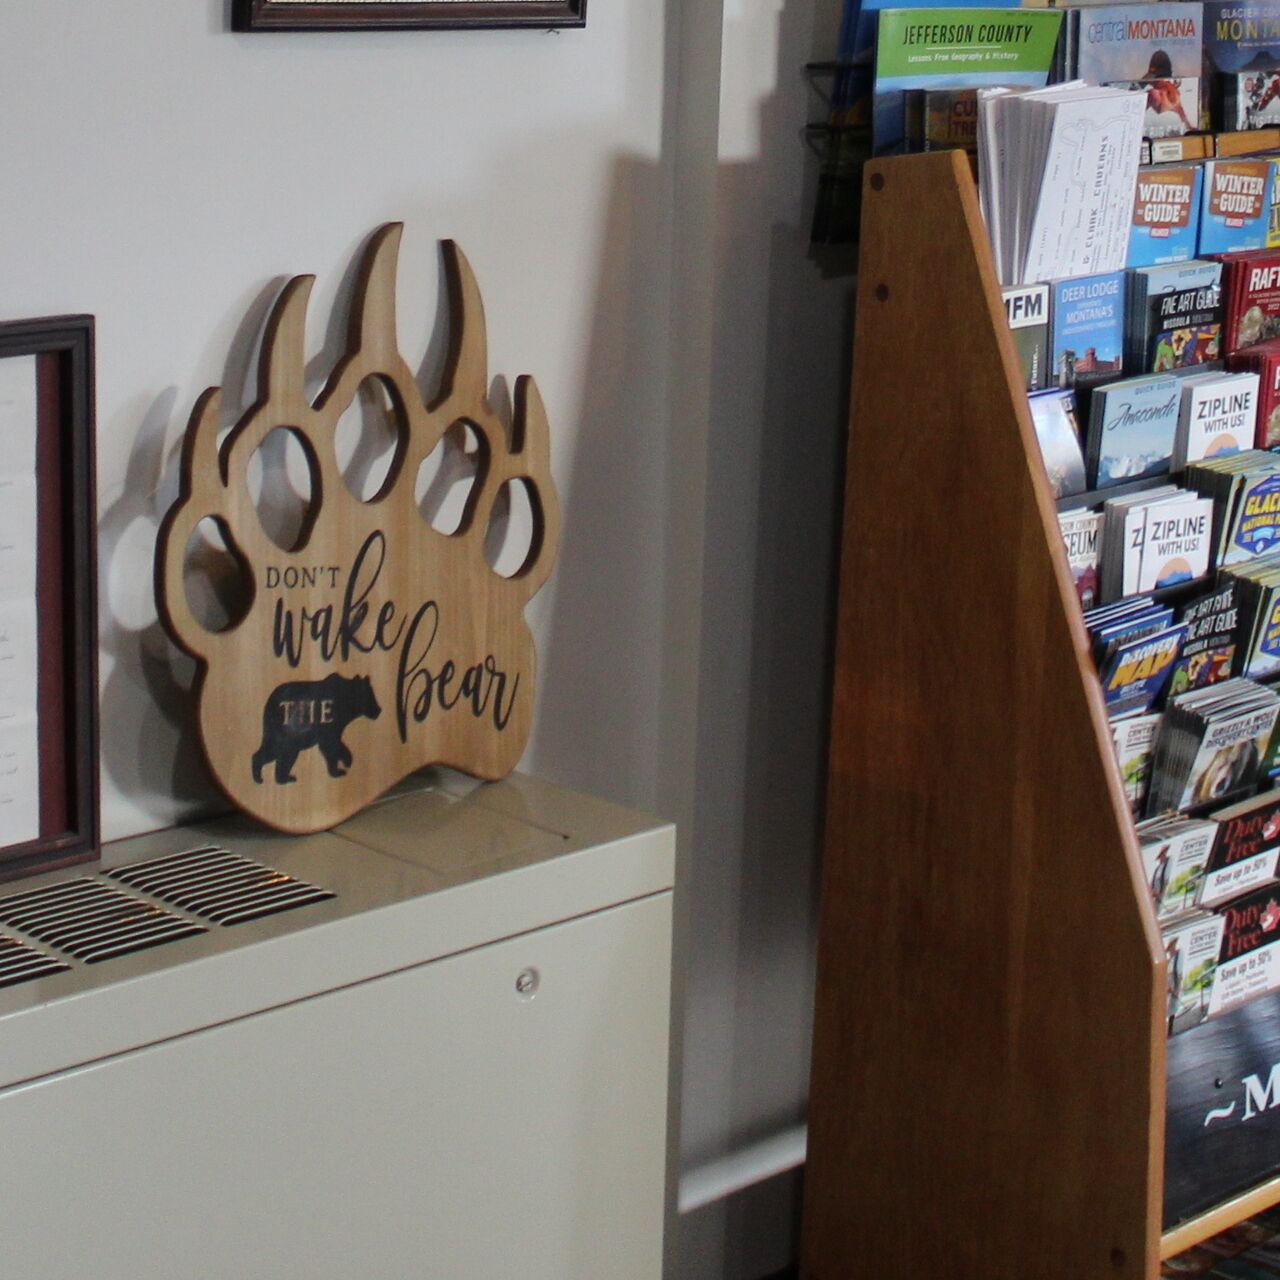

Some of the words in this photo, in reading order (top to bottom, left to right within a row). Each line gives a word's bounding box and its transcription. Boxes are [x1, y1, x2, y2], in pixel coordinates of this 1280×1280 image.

[903, 25, 974, 45] JEFFERSON
[978, 25, 1033, 43] COUNTY
[1139, 184, 1190, 203] WINTER
[1215, 173, 1264, 195] WINTER
[1144, 203, 1181, 223] GUIDE
[1219, 194, 1254, 214] GUIDE
[1062, 285, 1086, 303] DEER
[1087, 280, 1119, 298] LODGE
[1178, 291, 1197, 312] ART
[1197, 392, 1251, 420] ZIPLINE
[1204, 419, 1229, 434] WITH
[1231, 416, 1246, 429] US!
[1151, 516, 1206, 541] ZIPLINE
[1157, 540, 1182, 556] WITH
[1184, 537, 1200, 551] US!
[265, 566, 340, 589] DON'T
[273, 529, 407, 668] wake
[396, 600, 521, 745] bear
[1108, 645, 1178, 691] MAP
[279, 699, 335, 725] THE
[1214, 871, 1233, 887] Save
[1224, 903, 1262, 930] Duty
[1227, 930, 1262, 957] Free
[1220, 964, 1237, 982] Save
[1237, 961, 1247, 975] up
[1248, 957, 1256, 969] to
